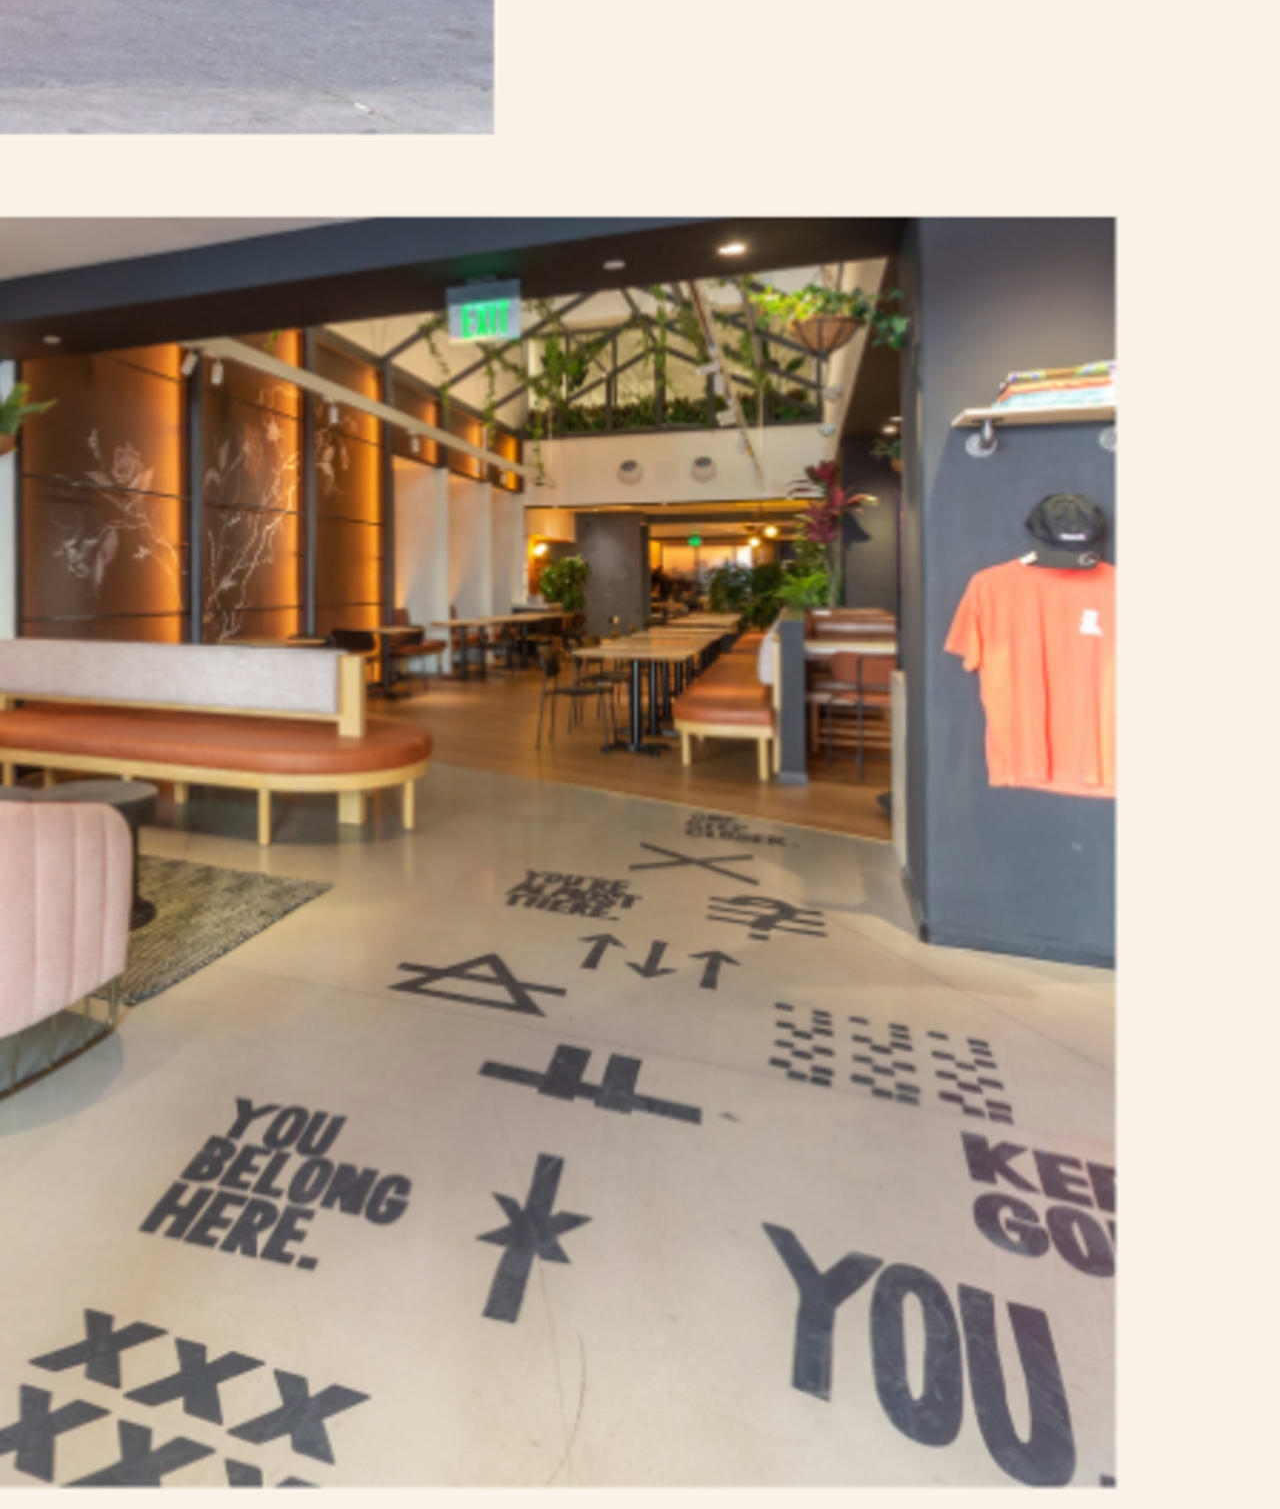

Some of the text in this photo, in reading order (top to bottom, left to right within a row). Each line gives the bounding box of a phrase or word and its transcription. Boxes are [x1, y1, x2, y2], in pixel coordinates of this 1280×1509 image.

[461, 299, 510, 339] EXIT
[225, 1096, 347, 1157] YOU
[138, 1180, 320, 1271] HERE.
[180, 1135, 413, 1226] BELONG
[761, 1220, 1077, 1488] YOU
